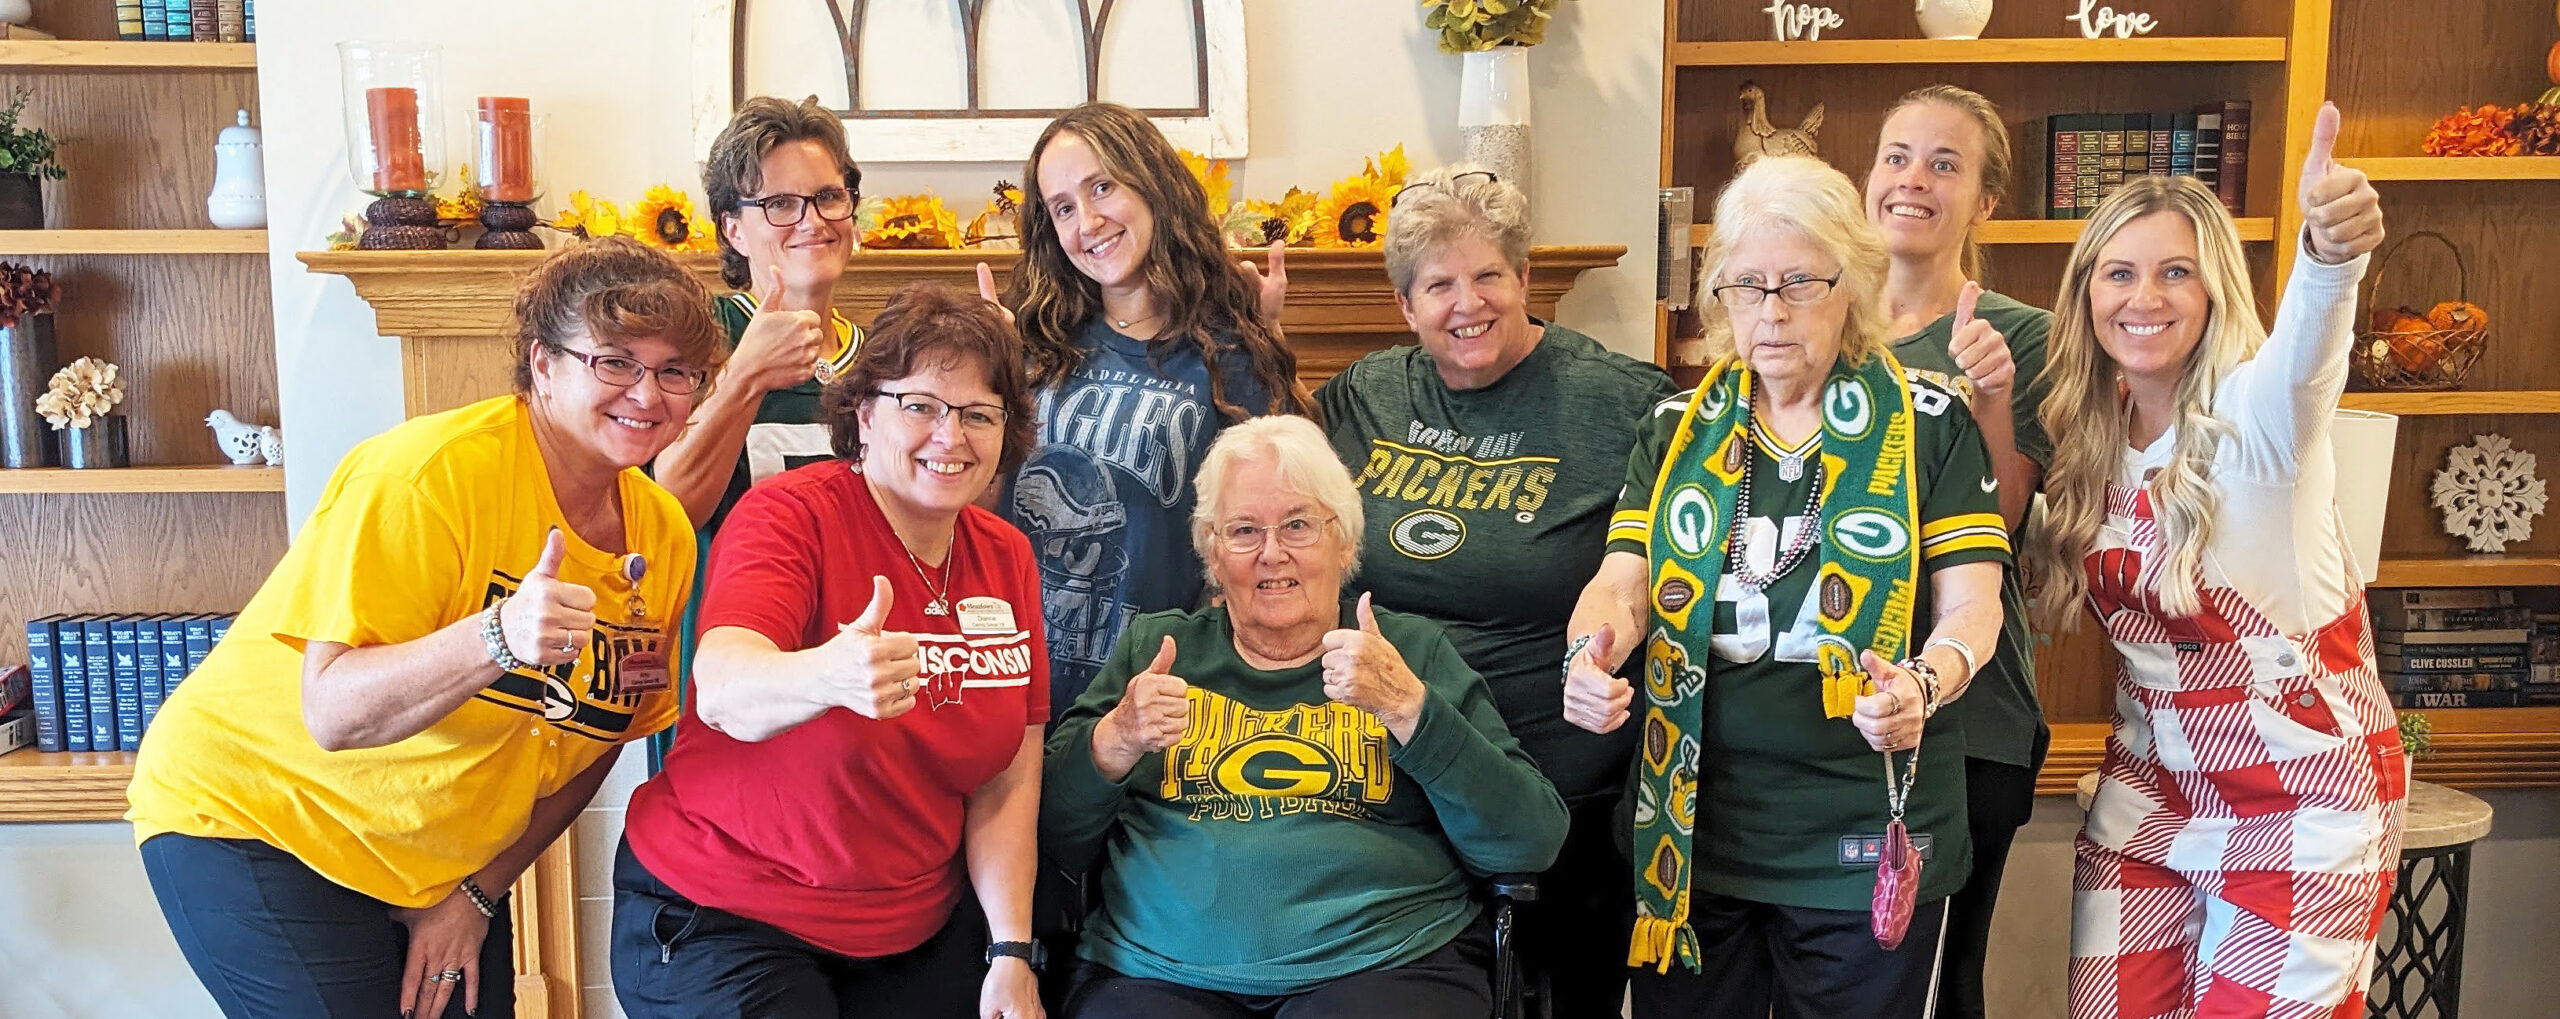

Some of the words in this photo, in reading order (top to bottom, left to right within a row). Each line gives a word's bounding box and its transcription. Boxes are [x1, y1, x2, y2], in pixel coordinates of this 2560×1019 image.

[1762, 0, 1844, 42] hope
[2066, 0, 2159, 39] love
[1071, 367, 1196, 396] LADELPHIA
[1036, 382, 1208, 509] AGLES
[1354, 448, 1557, 513] PACKERS
[1781, 465, 1800, 478] NFL
[1395, 512, 1460, 555] G
[1871, 578, 1911, 663] PACKER
[918, 644, 1031, 676] ISCONSI
[2410, 658, 2435, 669] CLIVE
[2435, 657, 2473, 669] CUSSLER
[2422, 693, 2467, 707] WAR
[1217, 739, 1331, 798] G
